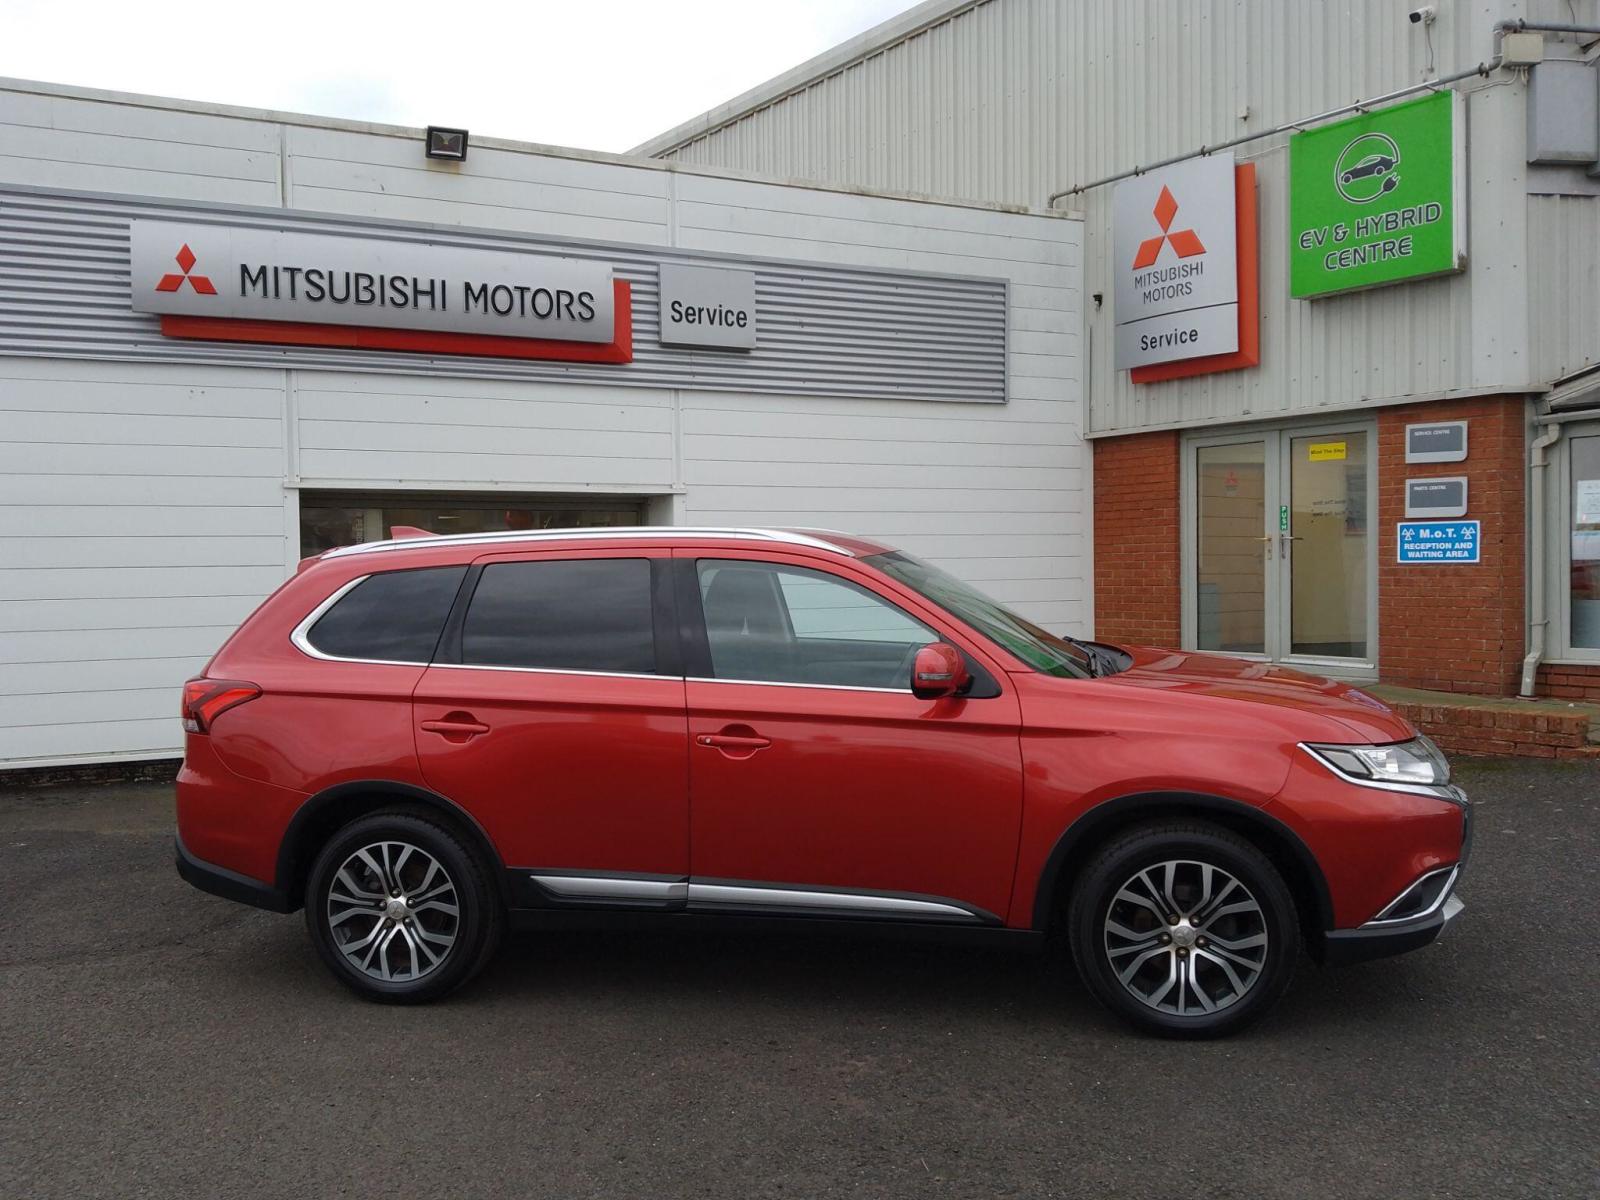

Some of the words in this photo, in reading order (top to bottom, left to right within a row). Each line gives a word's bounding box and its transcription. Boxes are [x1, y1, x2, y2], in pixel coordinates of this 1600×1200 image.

[1300, 227, 1328, 249] EV
[1333, 223, 1349, 242] &
[1355, 202, 1442, 238] HYBRID
[1325, 235, 1412, 271] CENTRE
[1134, 261, 1204, 289] MITSUBISHI
[240, 263, 446, 311] MITSUBISHI
[464, 281, 596, 322] MOTORS
[1143, 281, 1193, 304] MOTORS
[671, 299, 748, 328] Service
[1140, 327, 1199, 351] Service
[1420, 528, 1457, 539] M.o.T.
[1445, 550, 1469, 558] AREA
